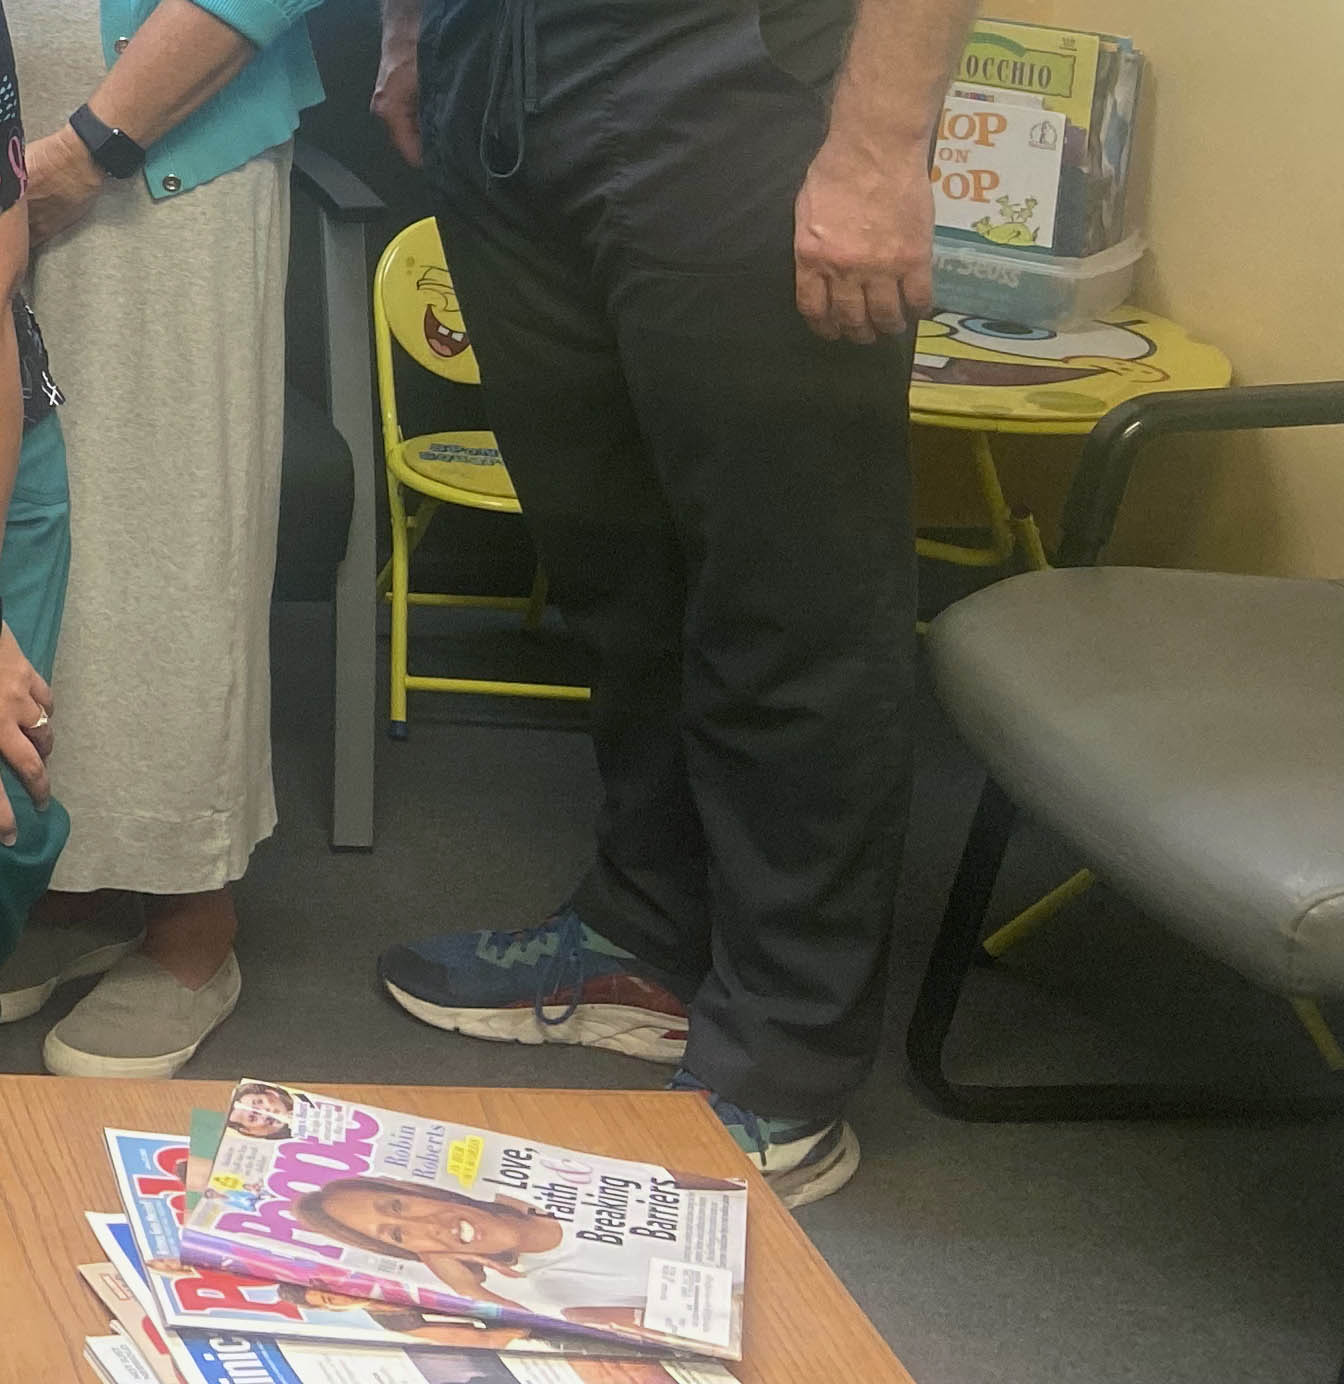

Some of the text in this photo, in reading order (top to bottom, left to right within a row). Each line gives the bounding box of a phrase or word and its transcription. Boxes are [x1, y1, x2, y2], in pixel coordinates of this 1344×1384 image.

[958, 54, 1052, 89] OCCHIO
[939, 148, 970, 164] ON
[930, 165, 1001, 204] OP
[384, 1124, 416, 1168] Robin
[412, 1124, 446, 1181] Roberts
[482, 1147, 541, 1191] Love,
[527, 1183, 579, 1224] Faith
[576, 1174, 642, 1247] Breaking
[628, 1176, 681, 1243] Barriers
